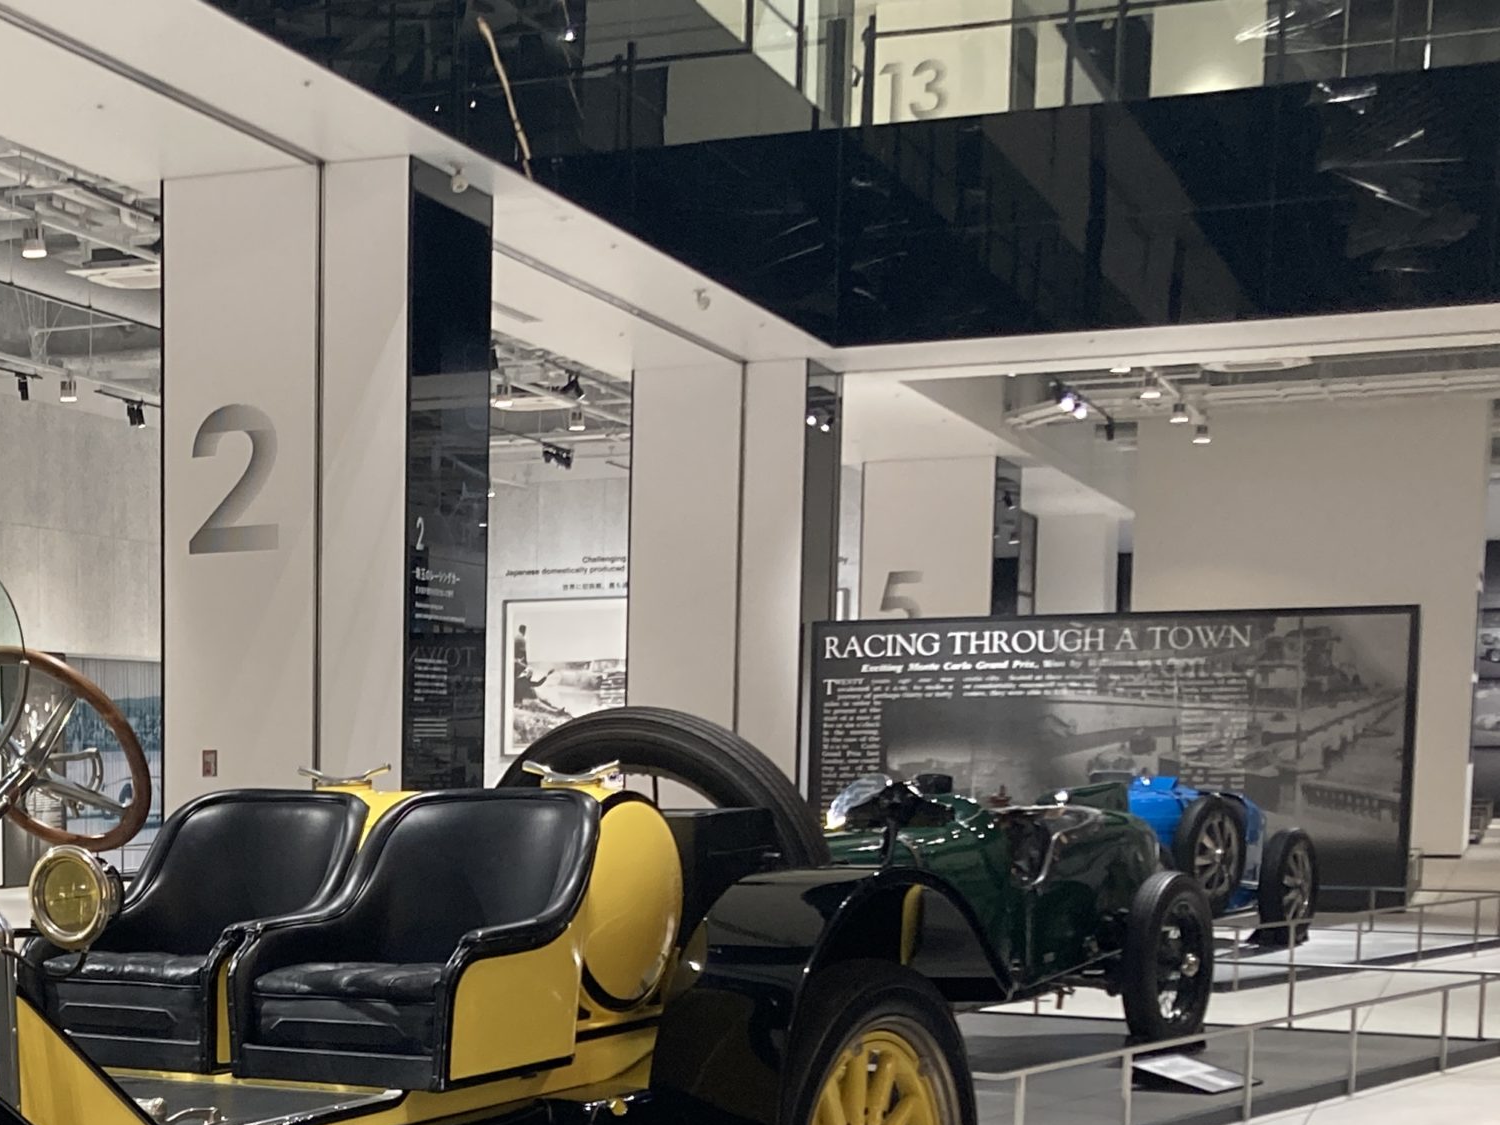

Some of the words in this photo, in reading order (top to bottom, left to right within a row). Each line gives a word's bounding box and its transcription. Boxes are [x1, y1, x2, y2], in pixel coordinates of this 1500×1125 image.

[879, 59, 948, 122] 13
[189, 403, 279, 555] 2
[416, 516, 425, 551] 2
[505, 569, 540, 577] Japanese
[582, 556, 626, 564] Challenging
[880, 570, 924, 618] 5
[824, 633, 940, 659] RACING
[947, 628, 1105, 655] THROUGH
[1115, 627, 1137, 650] A
[1147, 625, 1252, 650] TOWN
[861, 664, 904, 674] Exciting
[907, 662, 940, 672] Monte
[943, 661, 972, 671] Carlo
[975, 660, 1010, 670] Grand
